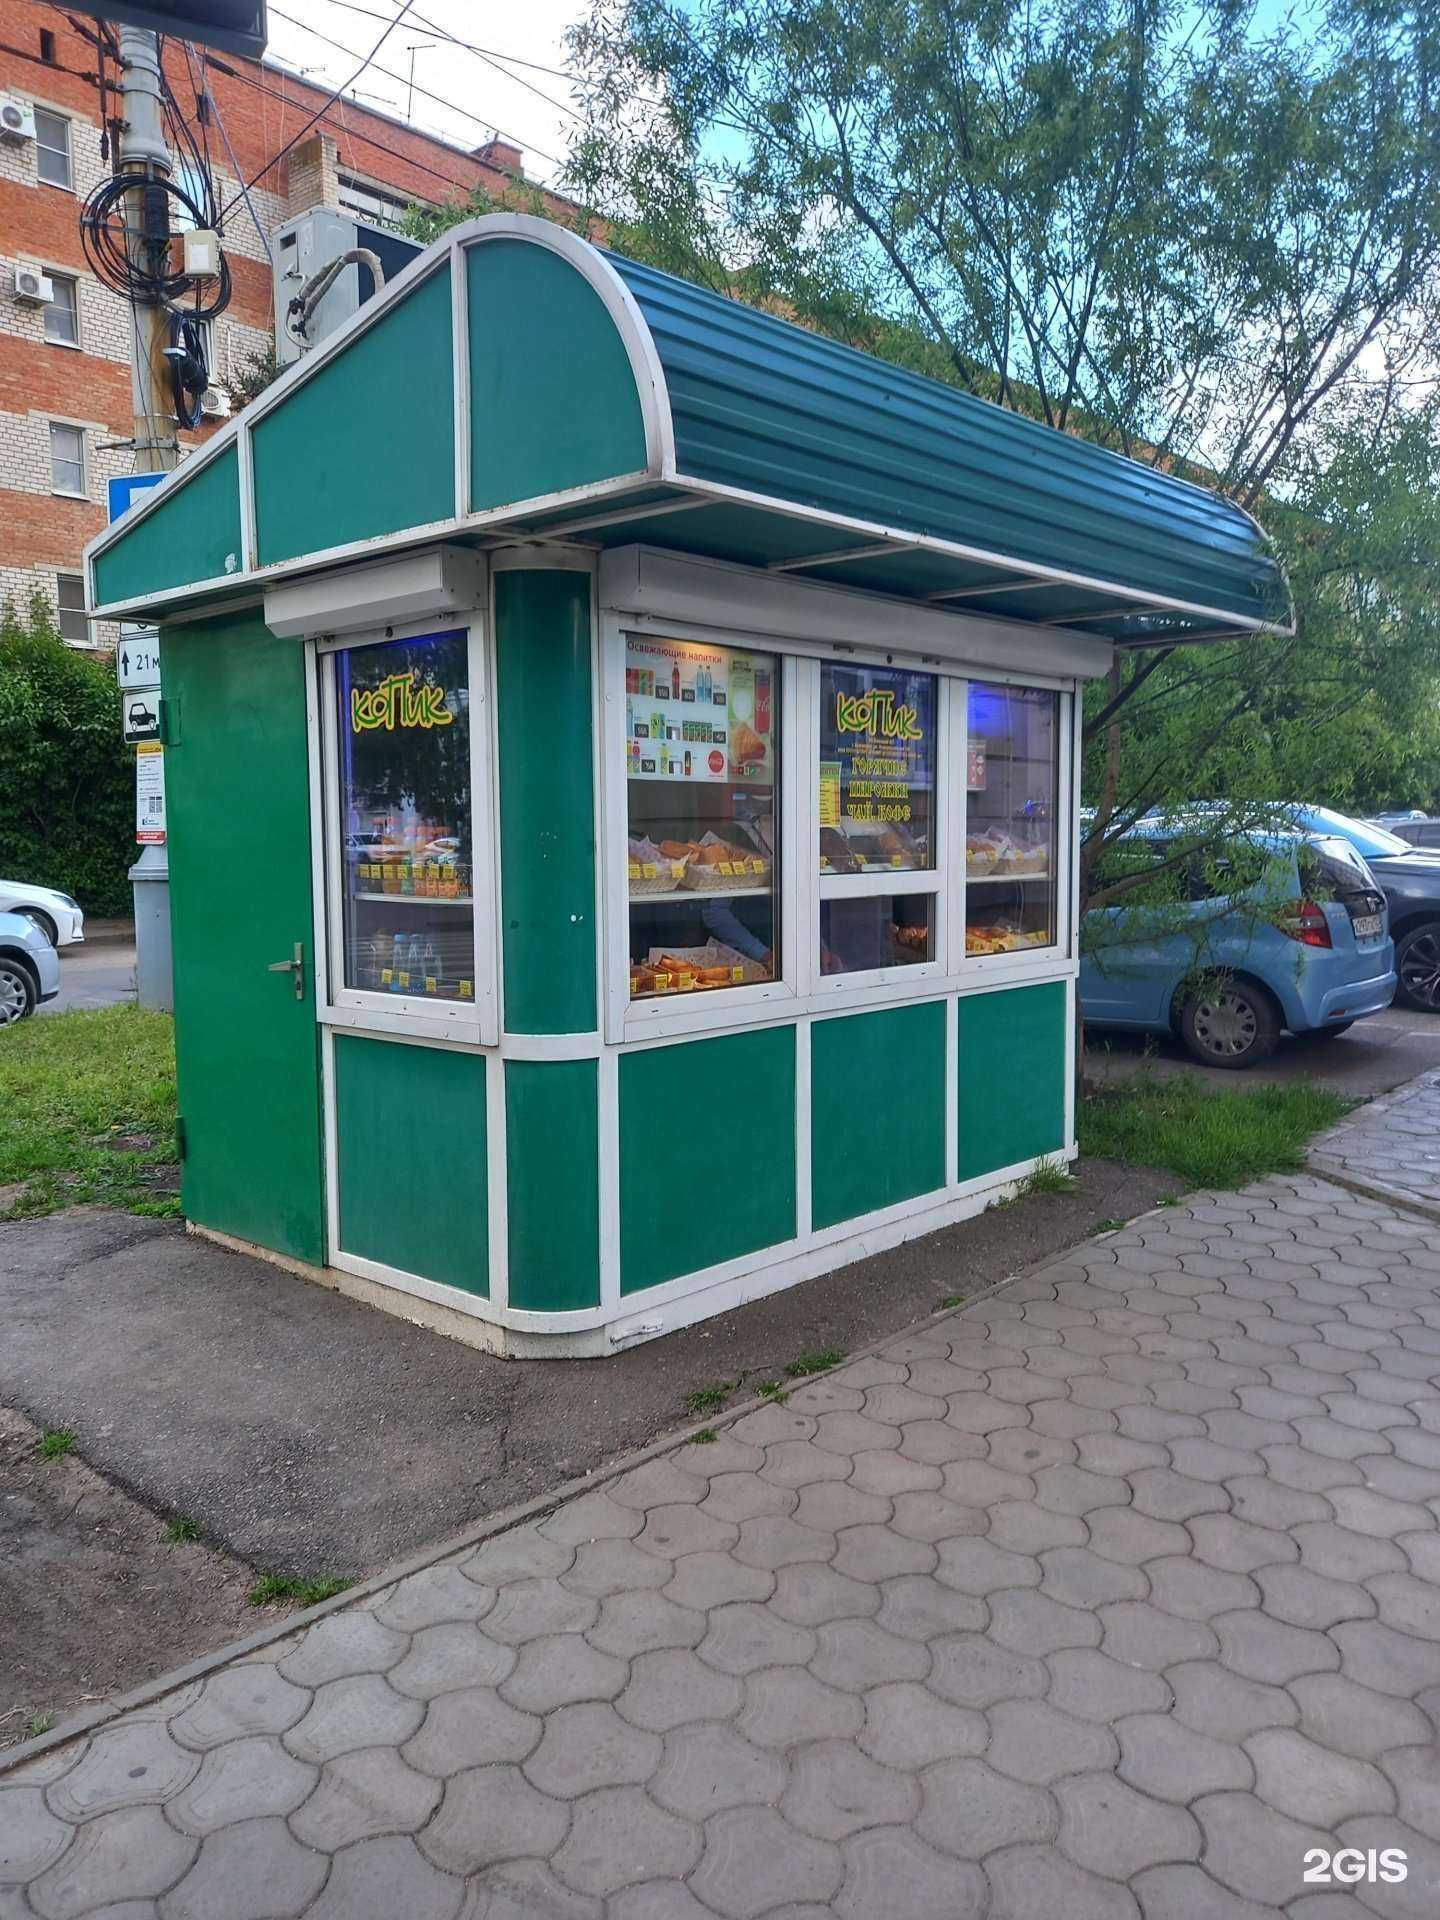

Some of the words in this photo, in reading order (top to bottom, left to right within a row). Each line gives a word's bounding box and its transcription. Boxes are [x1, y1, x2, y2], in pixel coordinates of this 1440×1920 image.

[136, 654, 149, 670] 21
[627, 640, 687, 660] Освежающие
[688, 651, 722, 664] напитки
[851, 756, 908, 777] ГОРЯЧИЕ
[848, 780, 909, 799] ПИРОЖКИ
